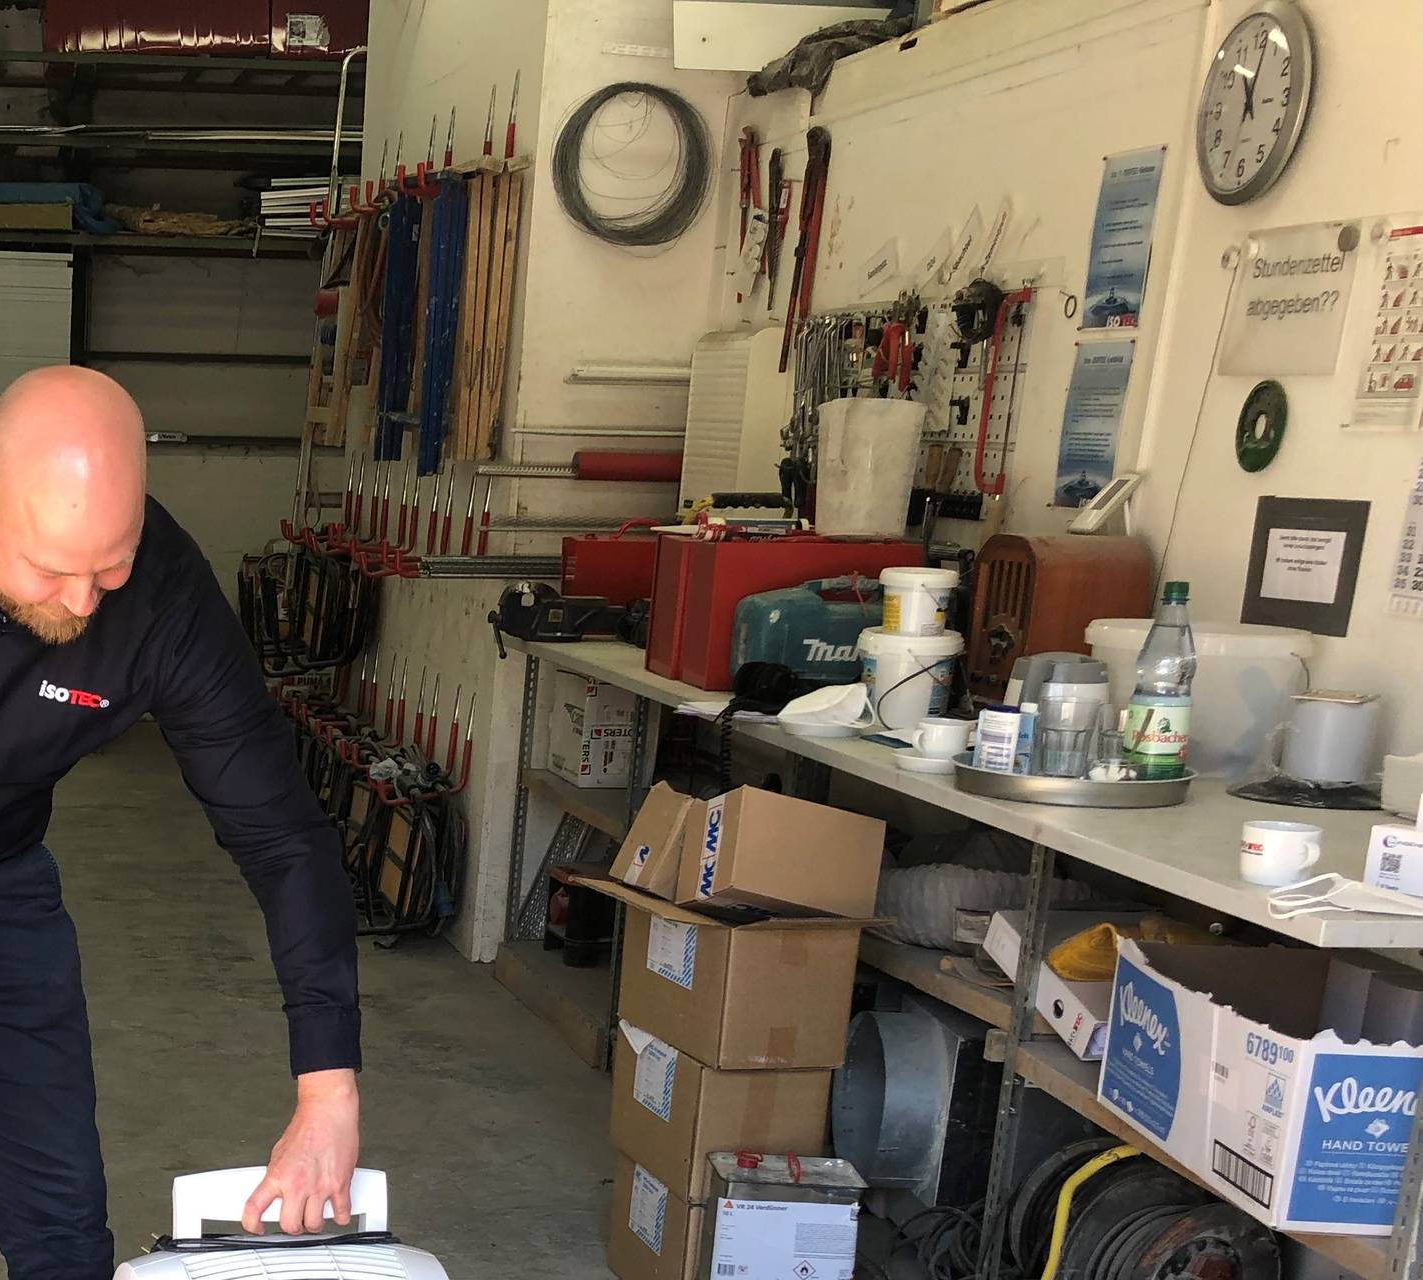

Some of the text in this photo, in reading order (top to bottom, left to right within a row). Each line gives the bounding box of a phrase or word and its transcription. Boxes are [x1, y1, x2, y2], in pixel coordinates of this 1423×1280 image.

[1254, 29, 1269, 50] 12
[1280, 57, 1290, 77] 2
[1281, 87, 1290, 107] 3
[1213, 102, 1222, 121] 9
[1272, 117, 1281, 136] 4
[1213, 129, 1222, 148] 8
[1222, 150, 1231, 168] 7
[1255, 144, 1265, 164] 5
[1237, 158, 1245, 178] 6
[1253, 250, 1346, 279] Stundenzettel
[1245, 289, 1340, 321] abgegeben??
[1246, 1032, 1295, 1065] 6789 100
[1314, 1077, 1418, 1123] Kleen
[1321, 1140, 1364, 1151] HAND
